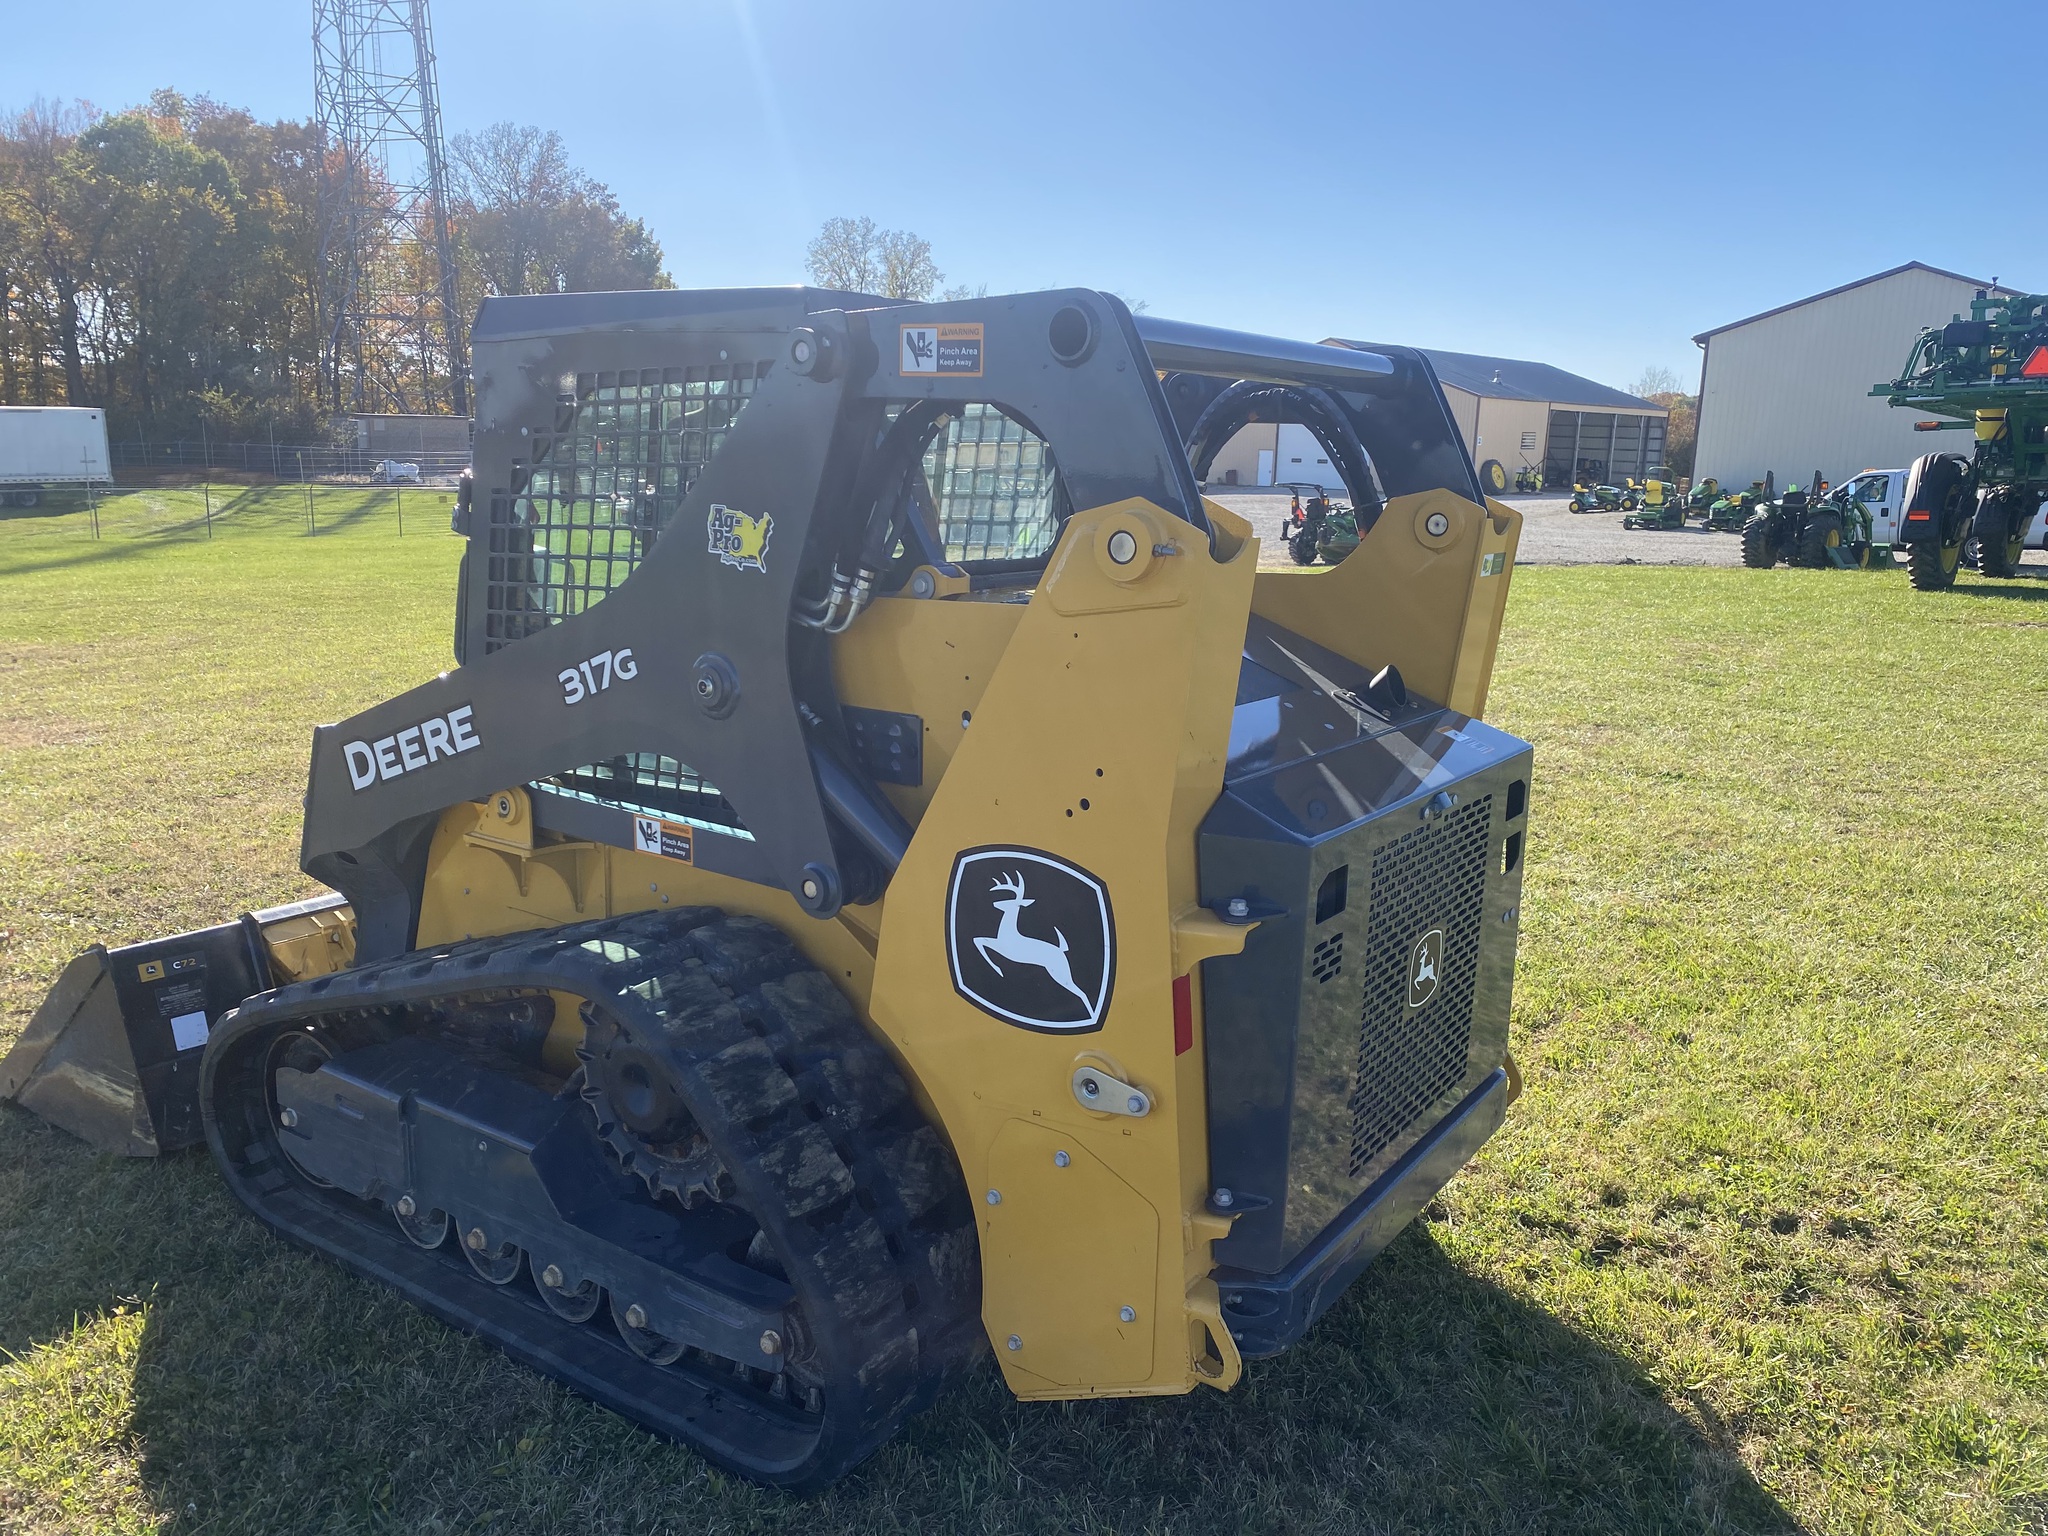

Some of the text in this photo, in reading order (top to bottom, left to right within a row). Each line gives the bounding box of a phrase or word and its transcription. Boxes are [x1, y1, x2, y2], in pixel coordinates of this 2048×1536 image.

[947, 328, 980, 336] WARNING
[940, 347, 978, 355] Pinch Area
[939, 358, 972, 367] Keep Away
[711, 528, 742, 552] Pro
[558, 648, 638, 705] 317G
[343, 705, 481, 791] DEERE
[662, 837, 689, 849] Pinch Area
[674, 848, 686, 856] Away
[173, 958, 197, 969] C72
